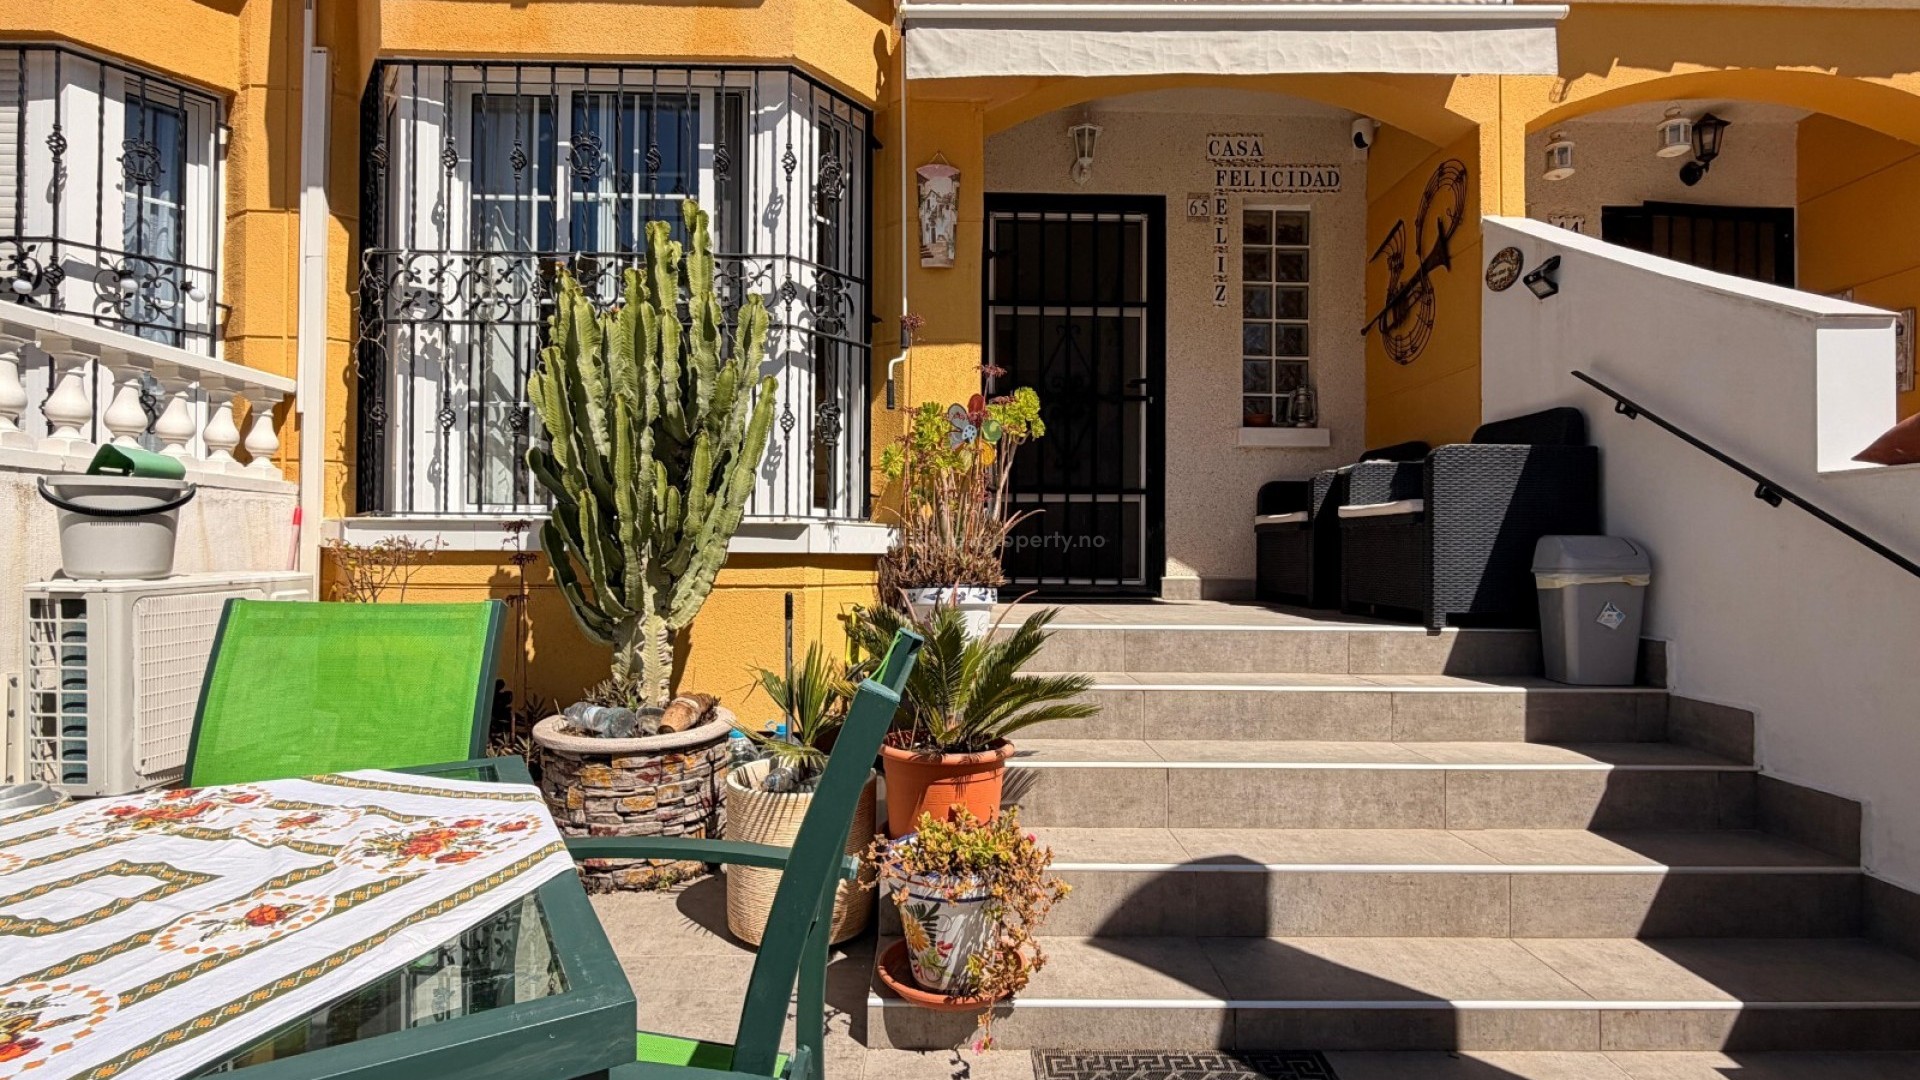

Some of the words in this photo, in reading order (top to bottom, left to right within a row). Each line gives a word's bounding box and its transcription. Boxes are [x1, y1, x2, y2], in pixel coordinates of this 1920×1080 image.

[1208, 139, 1264, 157] CASA
[1216, 169, 1340, 188] FELICIDAD
[1188, 199, 1209, 216] 65
